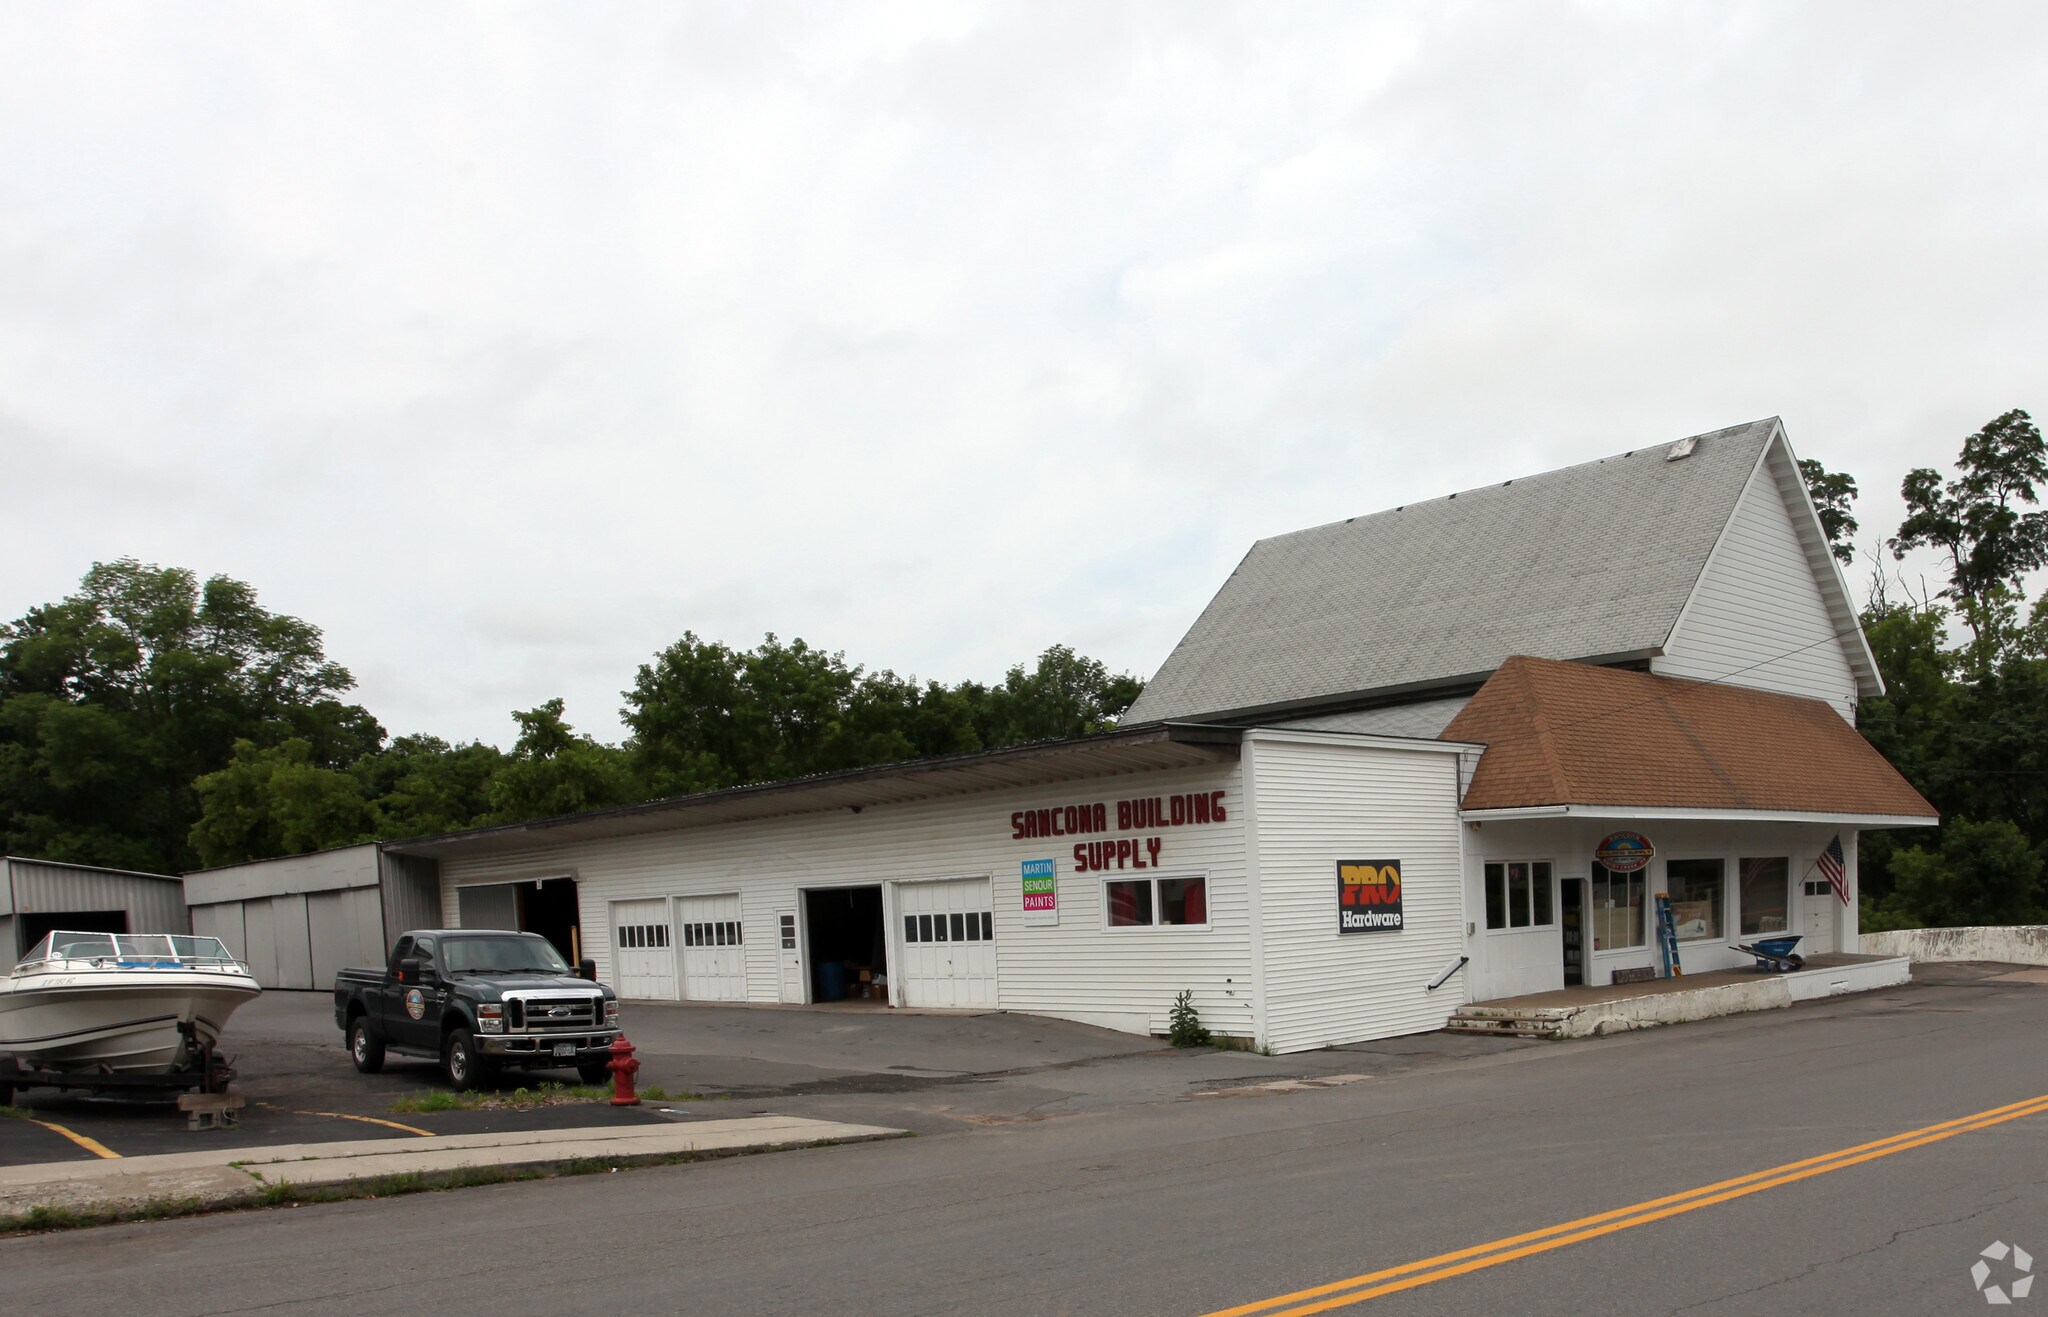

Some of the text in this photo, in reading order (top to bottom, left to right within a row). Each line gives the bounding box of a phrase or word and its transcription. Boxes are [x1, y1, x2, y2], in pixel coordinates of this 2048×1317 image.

[1011, 791, 1226, 839] SANCONA BUILDING
[1073, 837, 1161, 872] SUPPLY
[1023, 862, 1052, 875] MARTIN
[1024, 879, 1053, 892] SENOUR
[1341, 865, 1400, 905] PRO
[1024, 895, 1054, 908] PAINTS
[1342, 910, 1401, 928] Hardware
